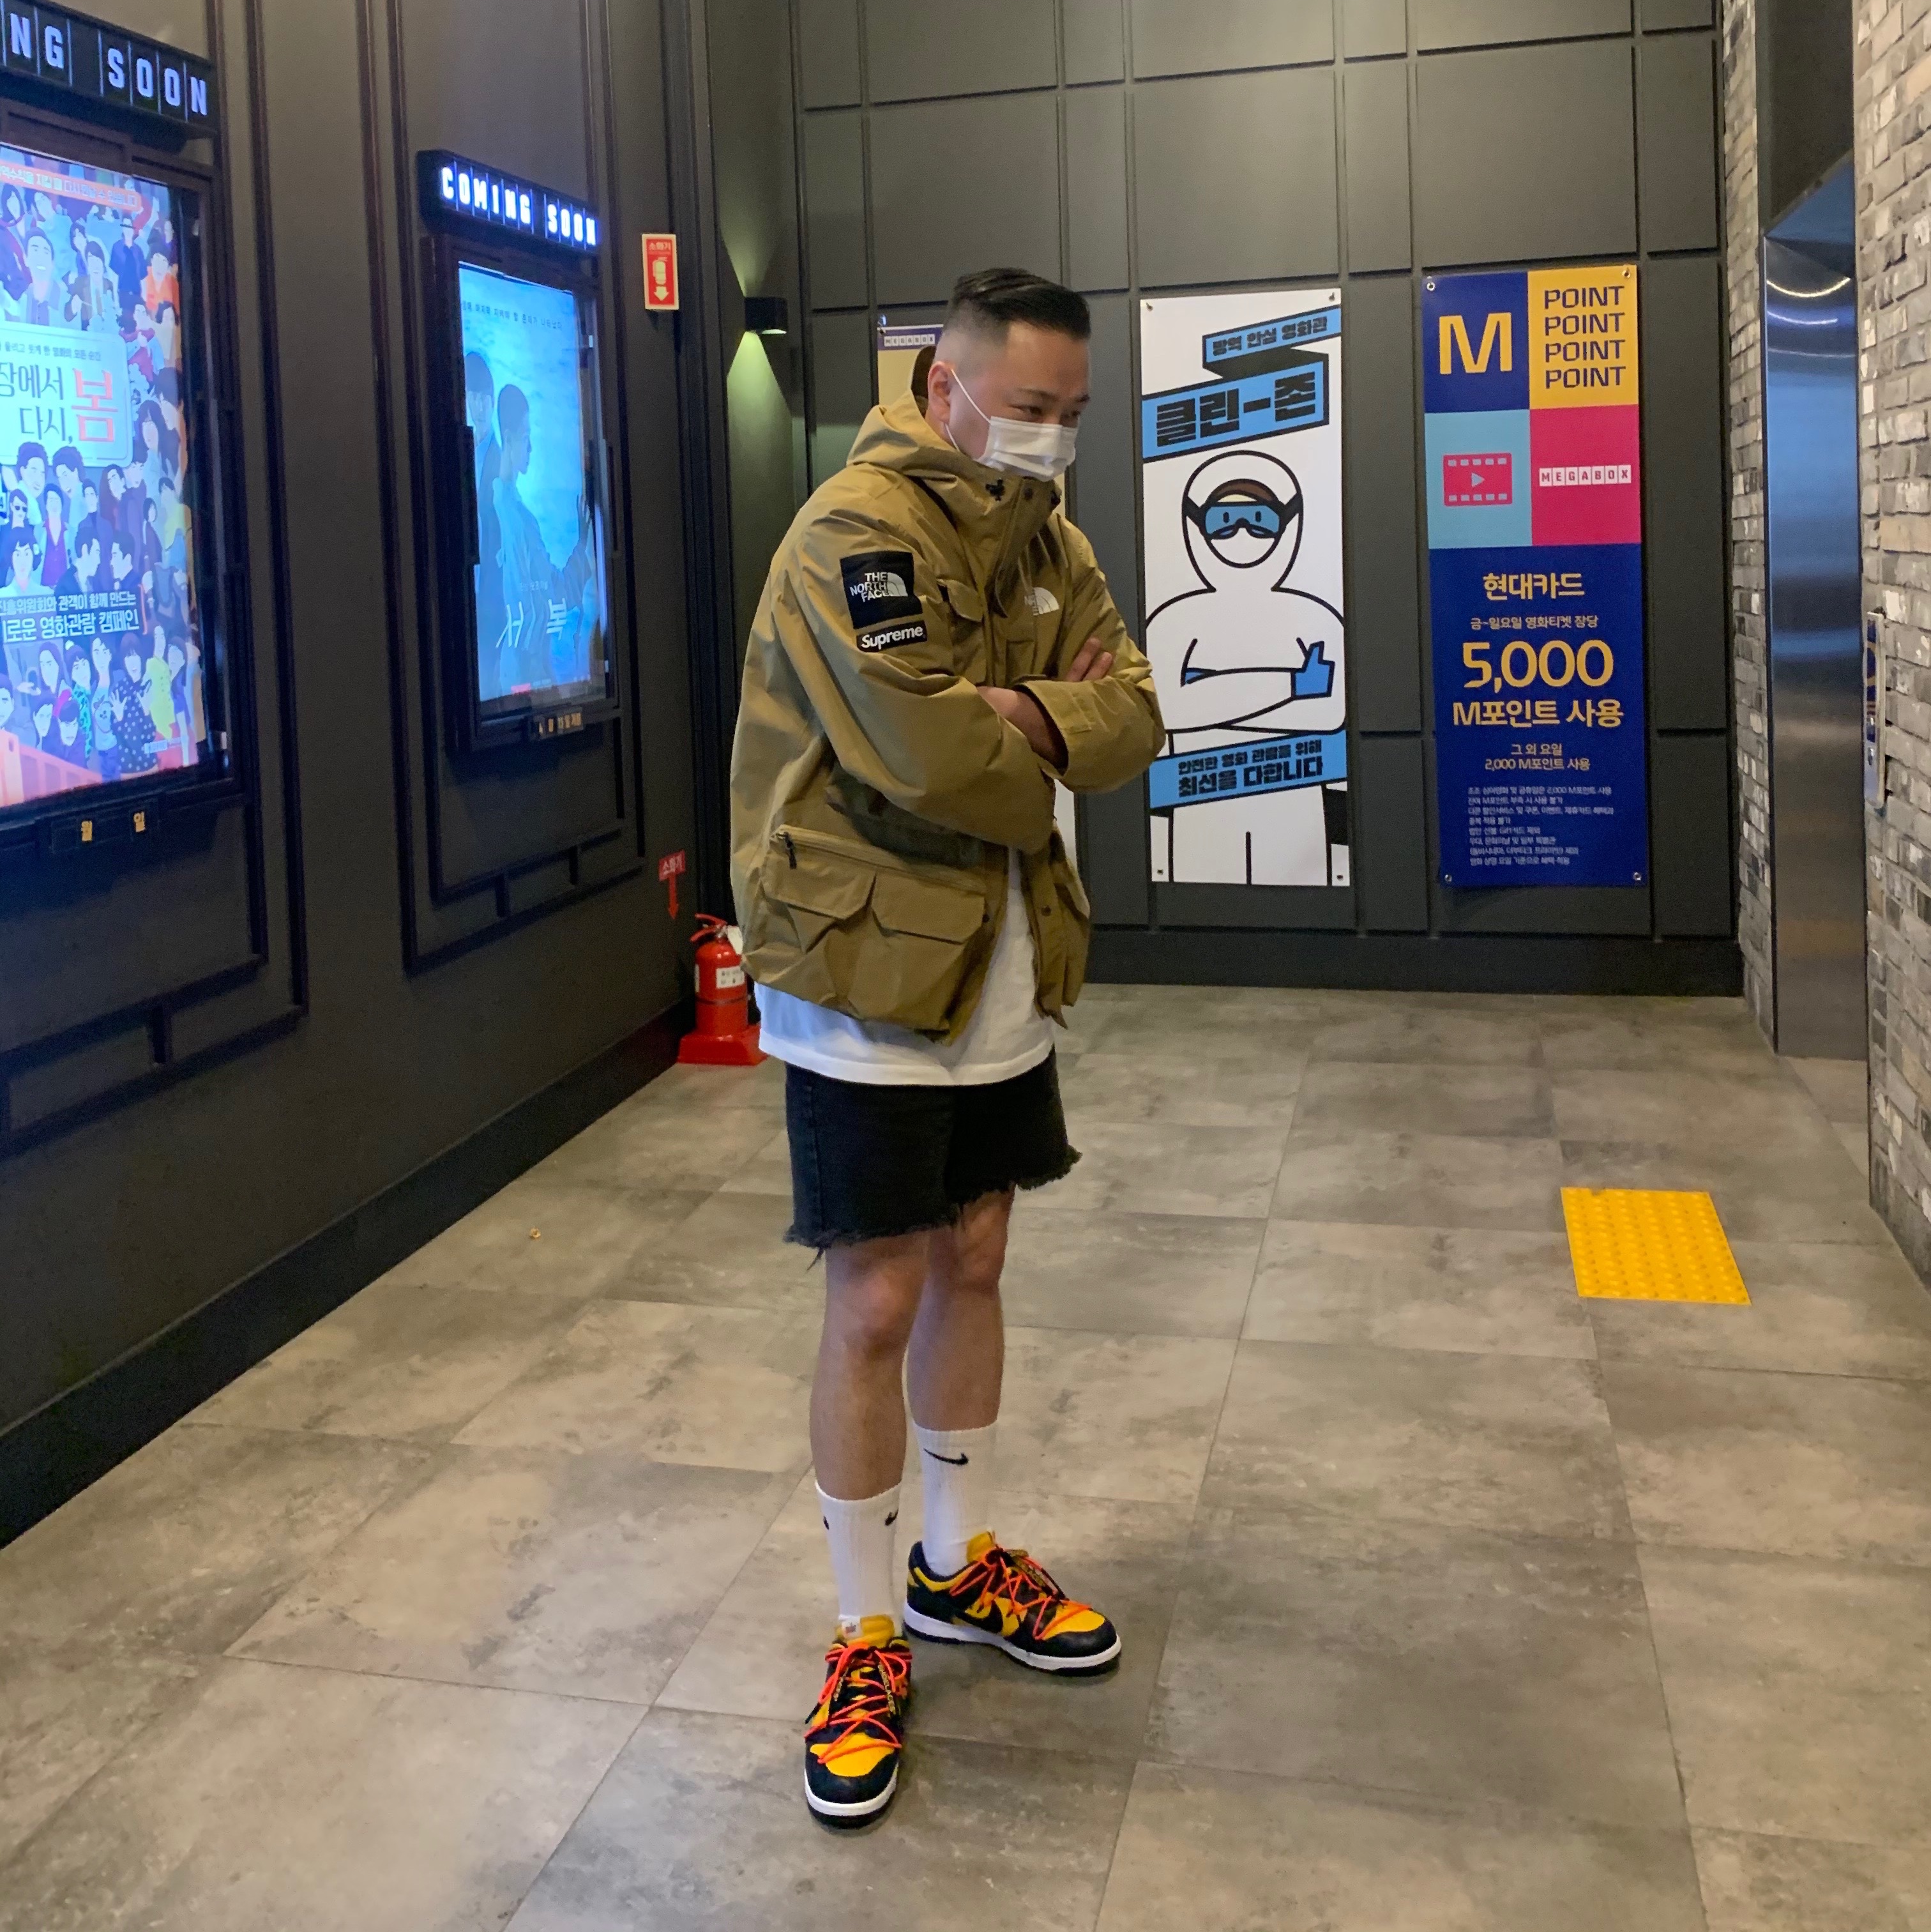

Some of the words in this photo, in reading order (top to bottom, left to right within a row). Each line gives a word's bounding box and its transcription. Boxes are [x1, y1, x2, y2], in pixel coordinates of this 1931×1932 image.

[107, 48, 208, 116] SOON
[441, 166, 531, 225] COMING
[547, 203, 596, 247] SOON
[1544, 285, 1625, 310] POINT
[1213, 335, 1242, 356] 방역
[1246, 327, 1276, 349] 안심
[1281, 316, 1328, 340] 영화관
[1544, 312, 1625, 336] POINT
[1439, 312, 1512, 375] M
[1545, 339, 1626, 363] POINT
[1545, 366, 1626, 390] POINT
[19, 405, 73, 445] 다시,
[72, 367, 119, 443] 봄
[1541, 469, 1629, 483] MEGABOX
[849, 581, 887, 597] NORTH
[864, 572, 888, 582] THE
[1482, 572, 1586, 600] 현대카드
[58, 593, 87, 612] 관객이
[89, 591, 109, 609] 함께
[109, 590, 137, 607] 만드는
[861, 589, 893, 603] FACE
[40, 611, 96, 639] 영화관람
[98, 608, 140, 634] 캠페인
[1471, 616, 1522, 630] 금~일요일
[1525, 614, 1572, 629] 영화티켓
[1575, 614, 1599, 628] 장당
[861, 626, 924, 650] Supreme
[1462, 639, 1614, 694] 5,000
[1453, 699, 1561, 728] M포인트
[1566, 699, 1624, 728] 사용
[1178, 756, 1218, 775] 안전한
[1222, 750, 1248, 768] 영화
[1252, 744, 1291, 764] 관람을
[1295, 739, 1322, 756] 위해
[1511, 743, 1523, 756] 그
[1525, 743, 1536, 756] 외
[1540, 743, 1563, 756] 요일
[1485, 758, 1517, 772] 2,000
[1518, 757, 1564, 771] M포인트
[1566, 757, 1591, 772] 사용
[1178, 769, 1238, 798] 최선을
[1243, 756, 1323, 787] 다합니다
